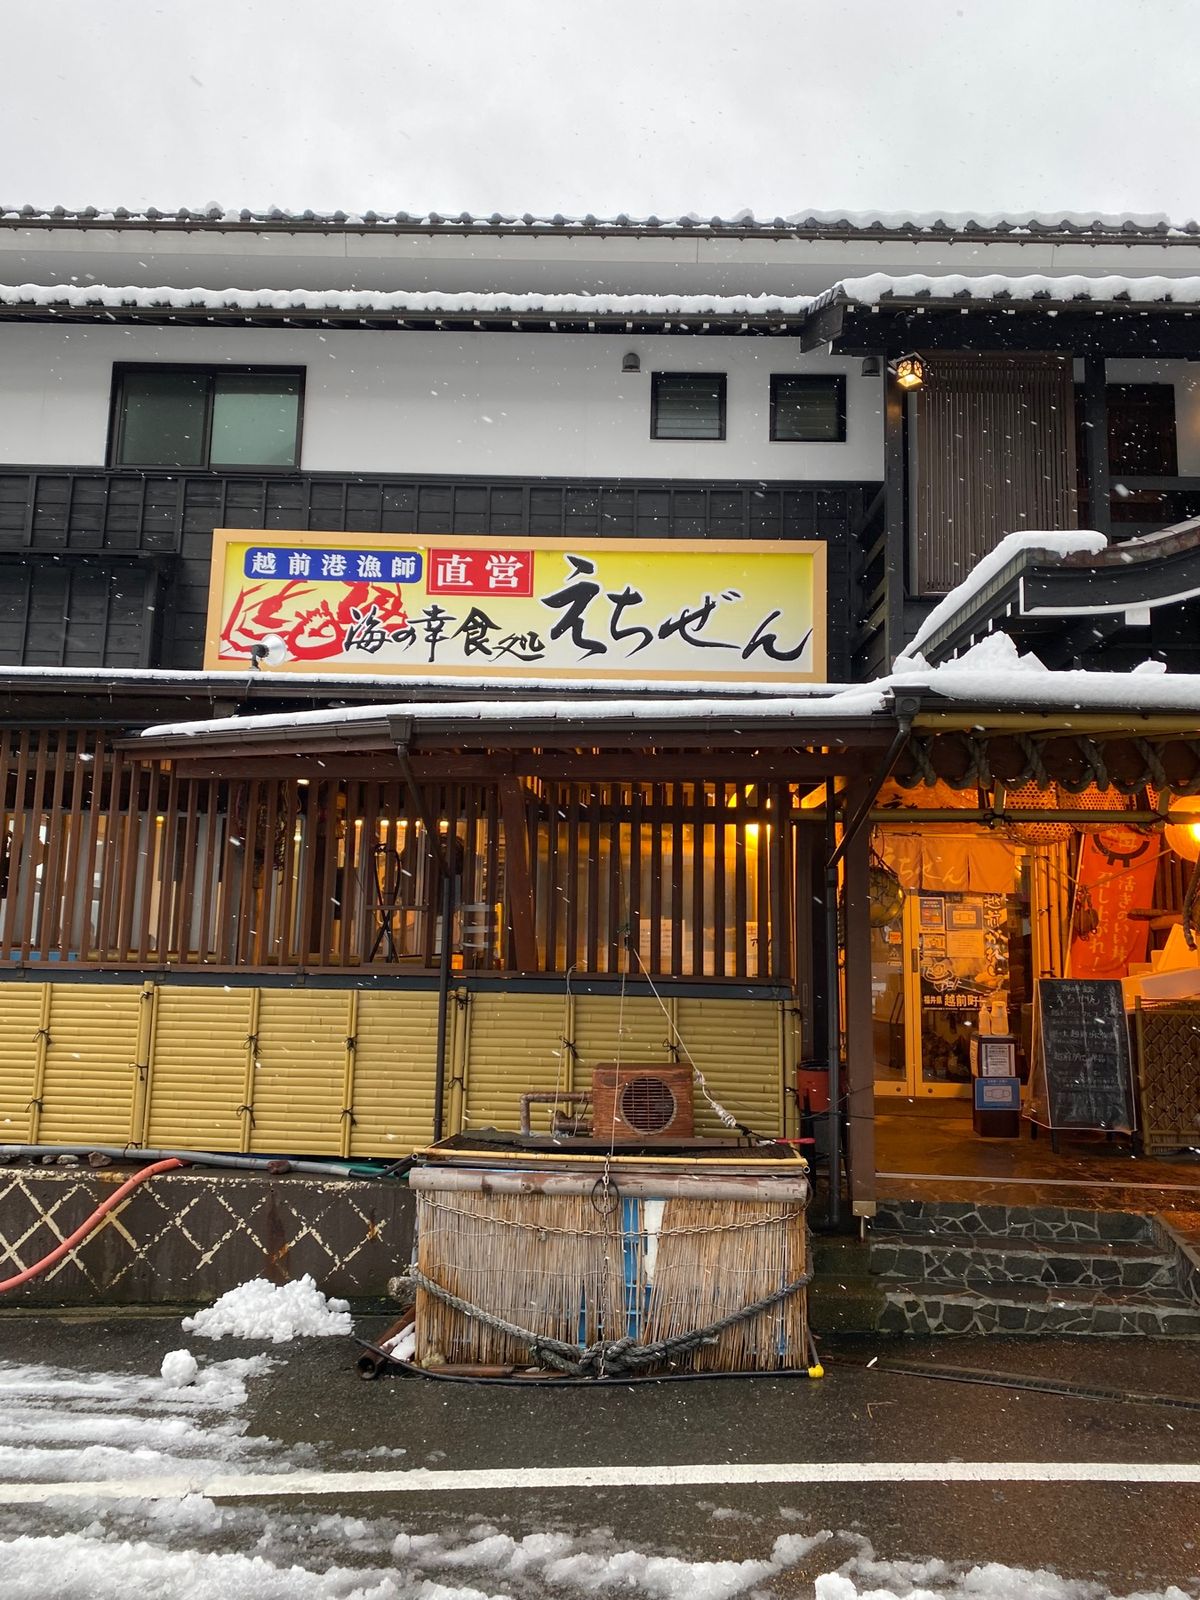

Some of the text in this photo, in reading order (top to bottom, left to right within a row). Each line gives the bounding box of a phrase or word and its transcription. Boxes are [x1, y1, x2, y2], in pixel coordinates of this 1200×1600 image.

[251, 552, 417, 580] 越前港漁師
[436, 555, 524, 589] 直営
[540, 553, 814, 663] えちぜん
